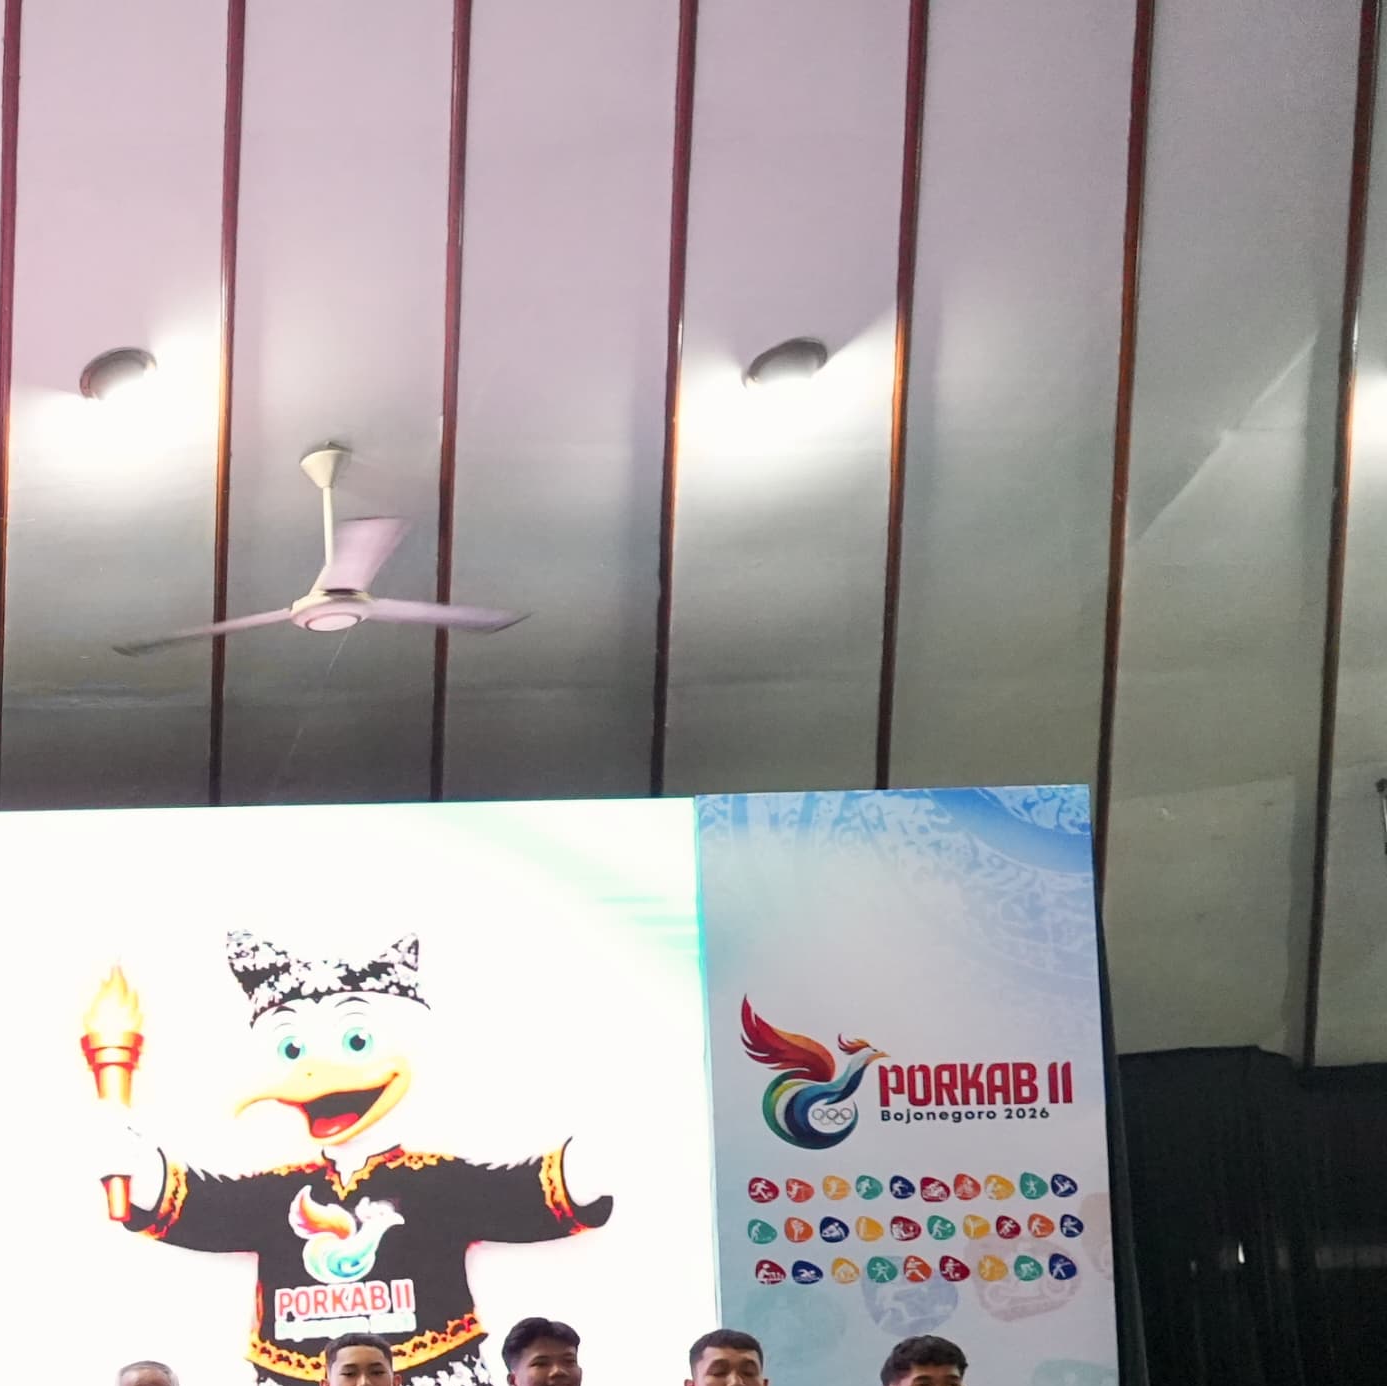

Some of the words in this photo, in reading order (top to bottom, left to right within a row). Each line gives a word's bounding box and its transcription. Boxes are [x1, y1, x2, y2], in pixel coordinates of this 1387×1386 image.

[879, 1063, 1038, 1107] PORKAB
[1048, 1061, 1073, 1104] II
[881, 1109, 996, 1124] Bojonegoro
[1005, 1108, 1049, 1119] 2026
[280, 1285, 386, 1316] PORKAB
[396, 1284, 410, 1309] II
